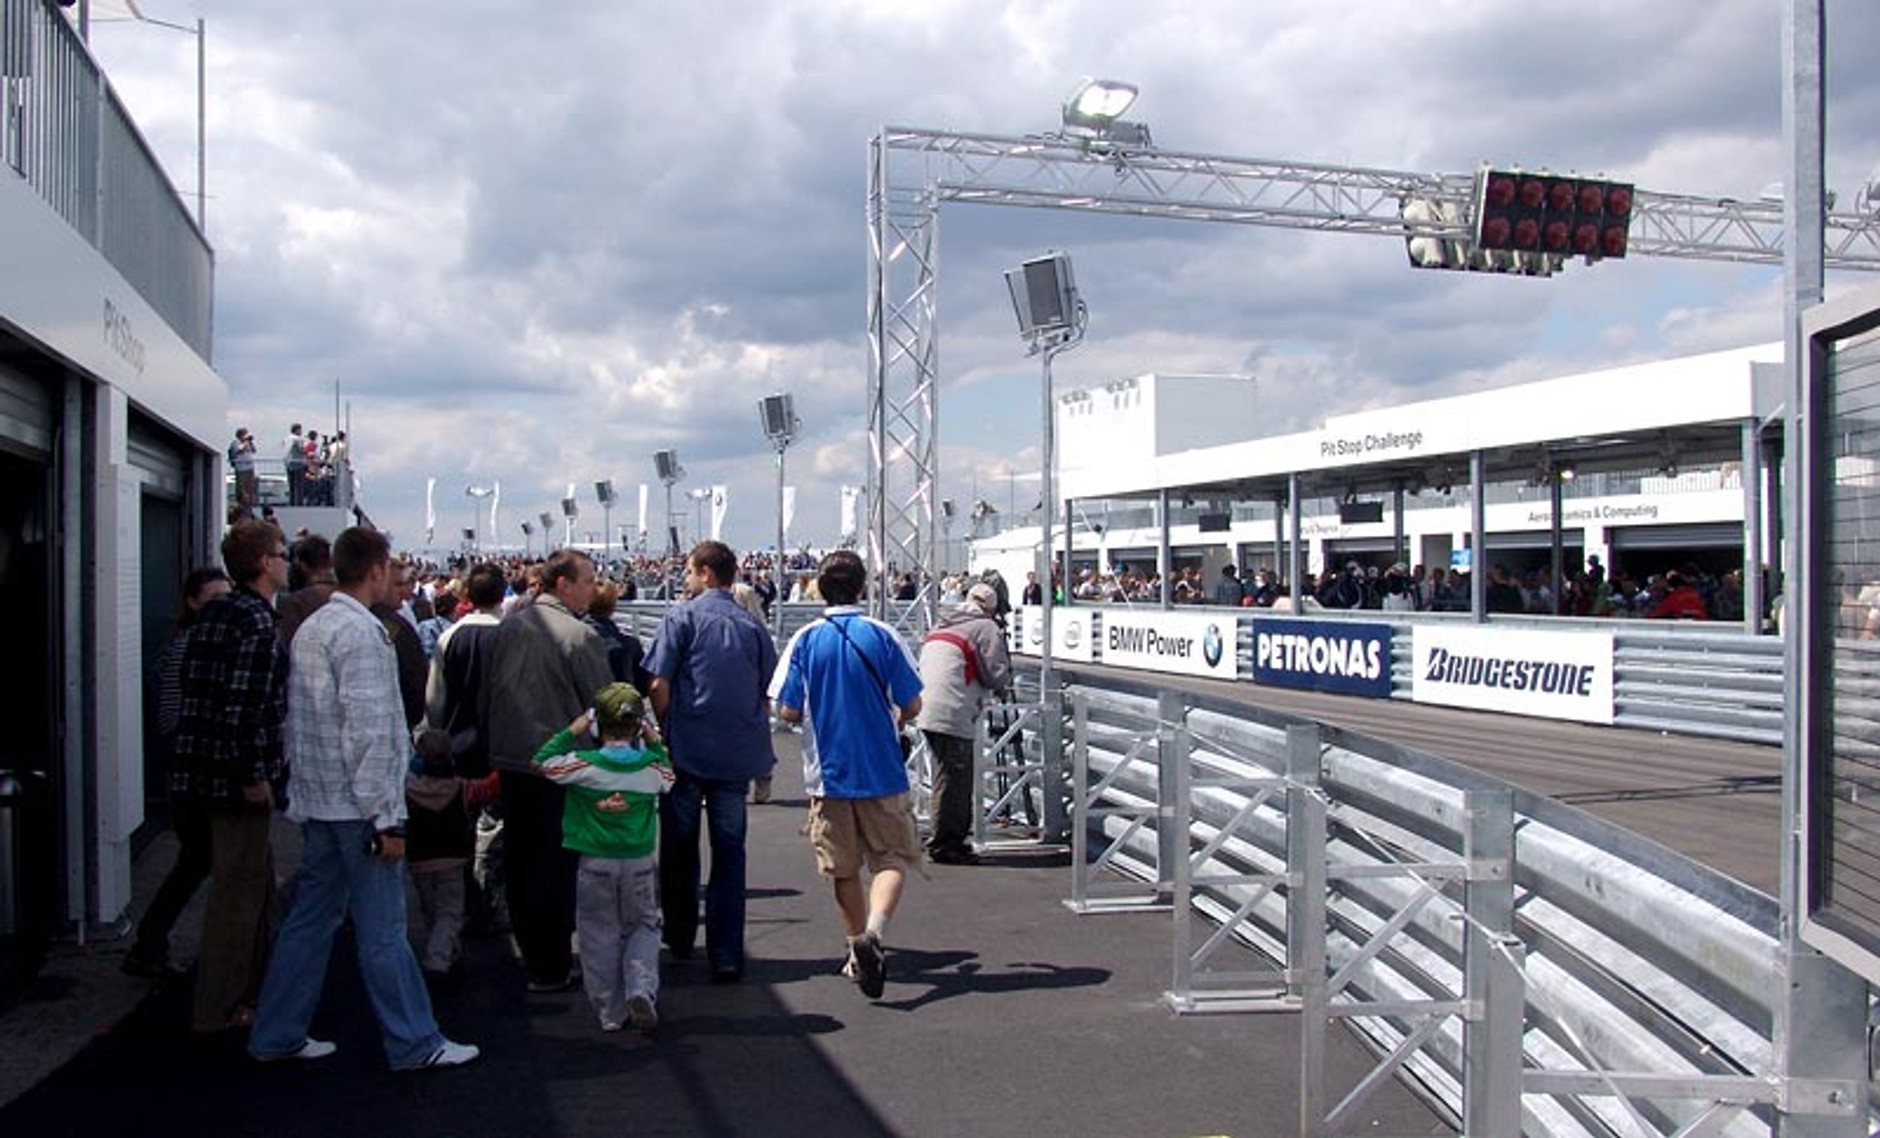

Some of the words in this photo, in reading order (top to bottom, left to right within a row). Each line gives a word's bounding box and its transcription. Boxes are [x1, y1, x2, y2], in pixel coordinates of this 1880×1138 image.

[1321, 441, 1336, 457] Pit
[1337, 439, 1362, 457] Stop
[1365, 431, 1423, 451] Challenge
[1528, 508, 1592, 522] Aeroamics
[1594, 506, 1601, 519] &
[1603, 504, 1658, 518] Computing
[1109, 625, 1145, 653] BMW
[1147, 628, 1194, 657] Power
[1257, 632, 1381, 680] PETRONAS
[1425, 647, 1595, 696] BRIDGESTONE
